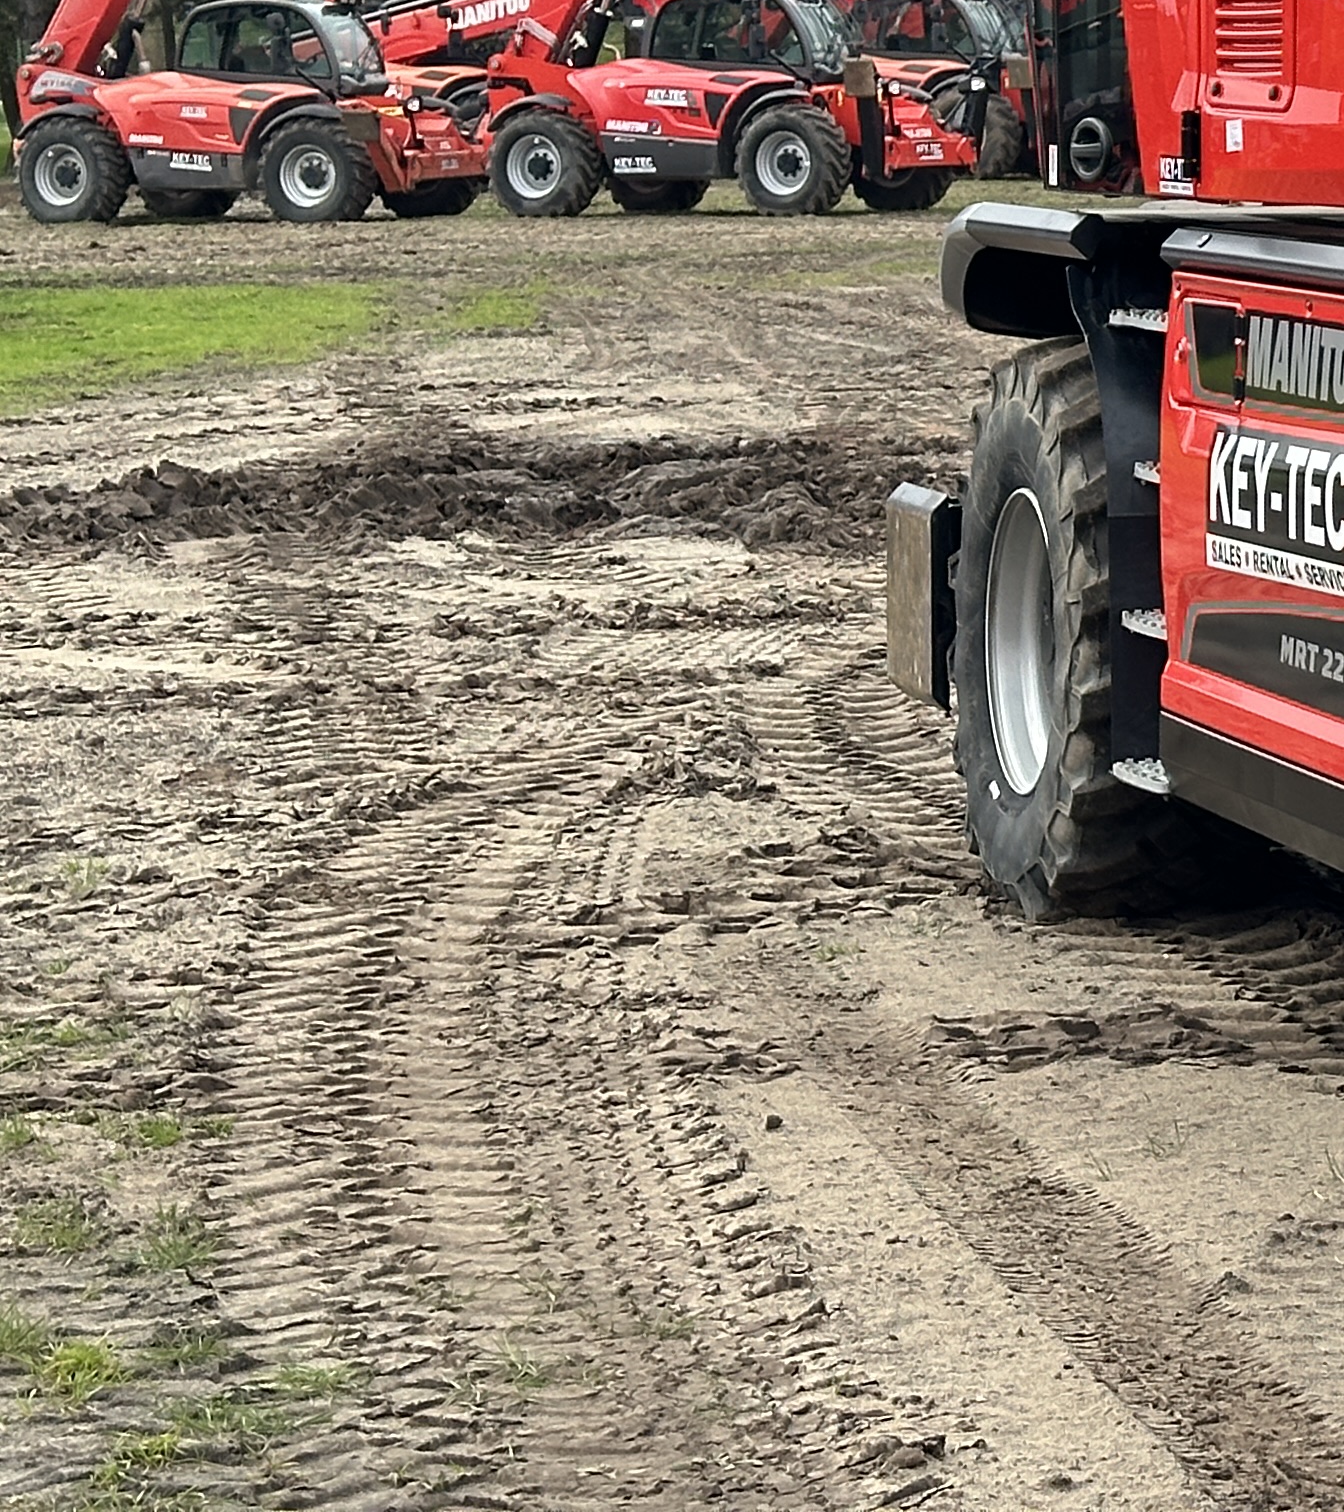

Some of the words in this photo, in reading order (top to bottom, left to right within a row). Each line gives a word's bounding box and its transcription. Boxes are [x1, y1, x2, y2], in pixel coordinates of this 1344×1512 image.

[1160, 157, 1192, 181] KEY-T
[1211, 540, 1242, 568] SALES
[1253, 550, 1295, 581] RENTAL
[1280, 634, 1319, 674] MRT
